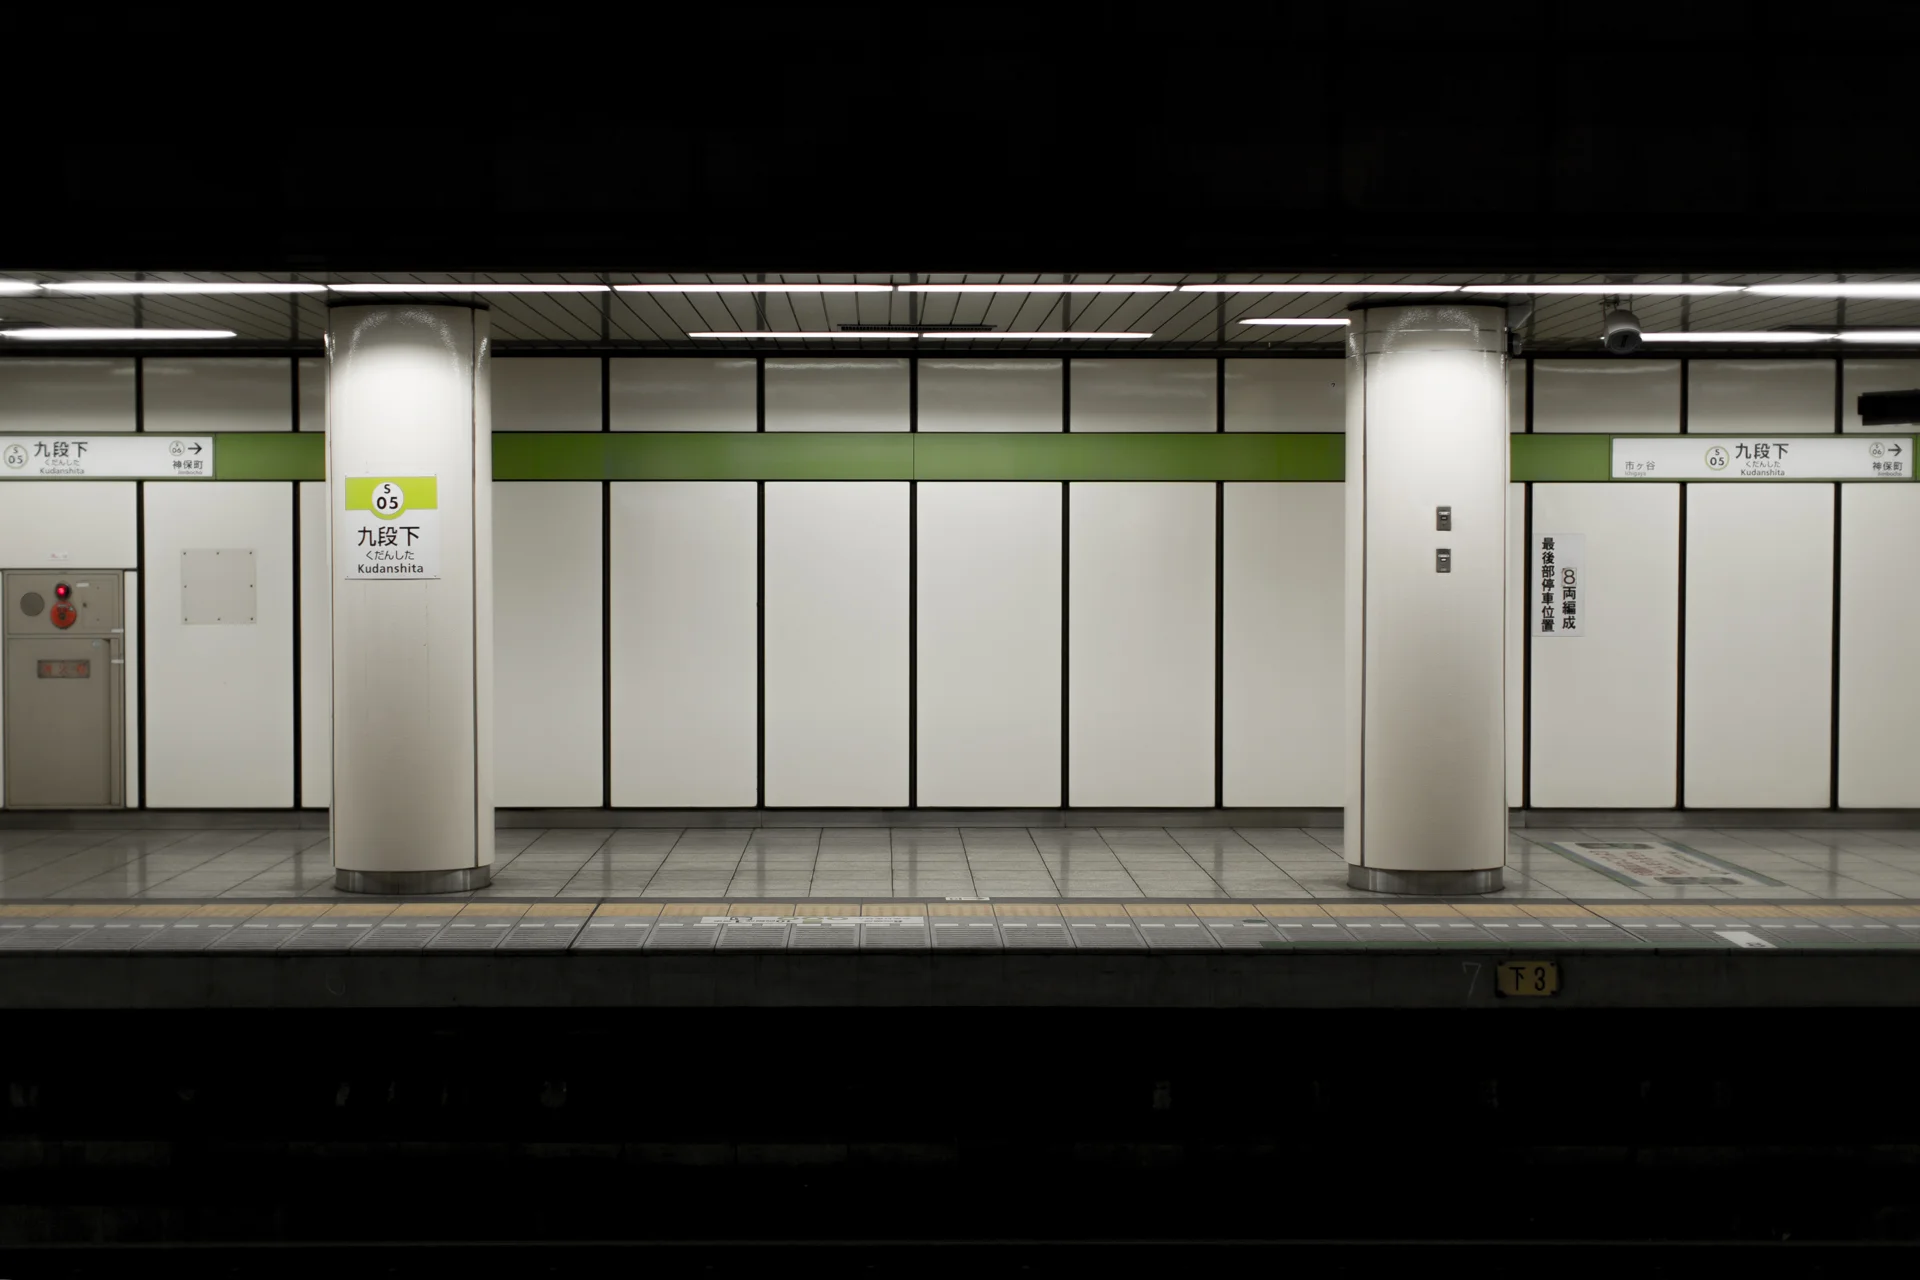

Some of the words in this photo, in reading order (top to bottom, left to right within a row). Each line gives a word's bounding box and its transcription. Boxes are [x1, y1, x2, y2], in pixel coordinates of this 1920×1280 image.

[13, 446, 19, 454] S
[34, 441, 89, 458] 九段下
[1735, 443, 1789, 460] 九段下
[8, 455, 24, 464] 05
[172, 460, 204, 470] 神保町
[1710, 457, 1725, 466] 05
[39, 467, 85, 475] Kudanshita
[1872, 462, 1903, 471] 神保町
[384, 484, 391, 494] S
[377, 496, 398, 510] 05
[358, 526, 420, 547] 九段下
[366, 550, 415, 561] くだんした
[357, 563, 424, 574] Kudanshita
[1541, 537, 1555, 633] 最後部停車位置
[1562, 569, 1577, 630] 8両編成
